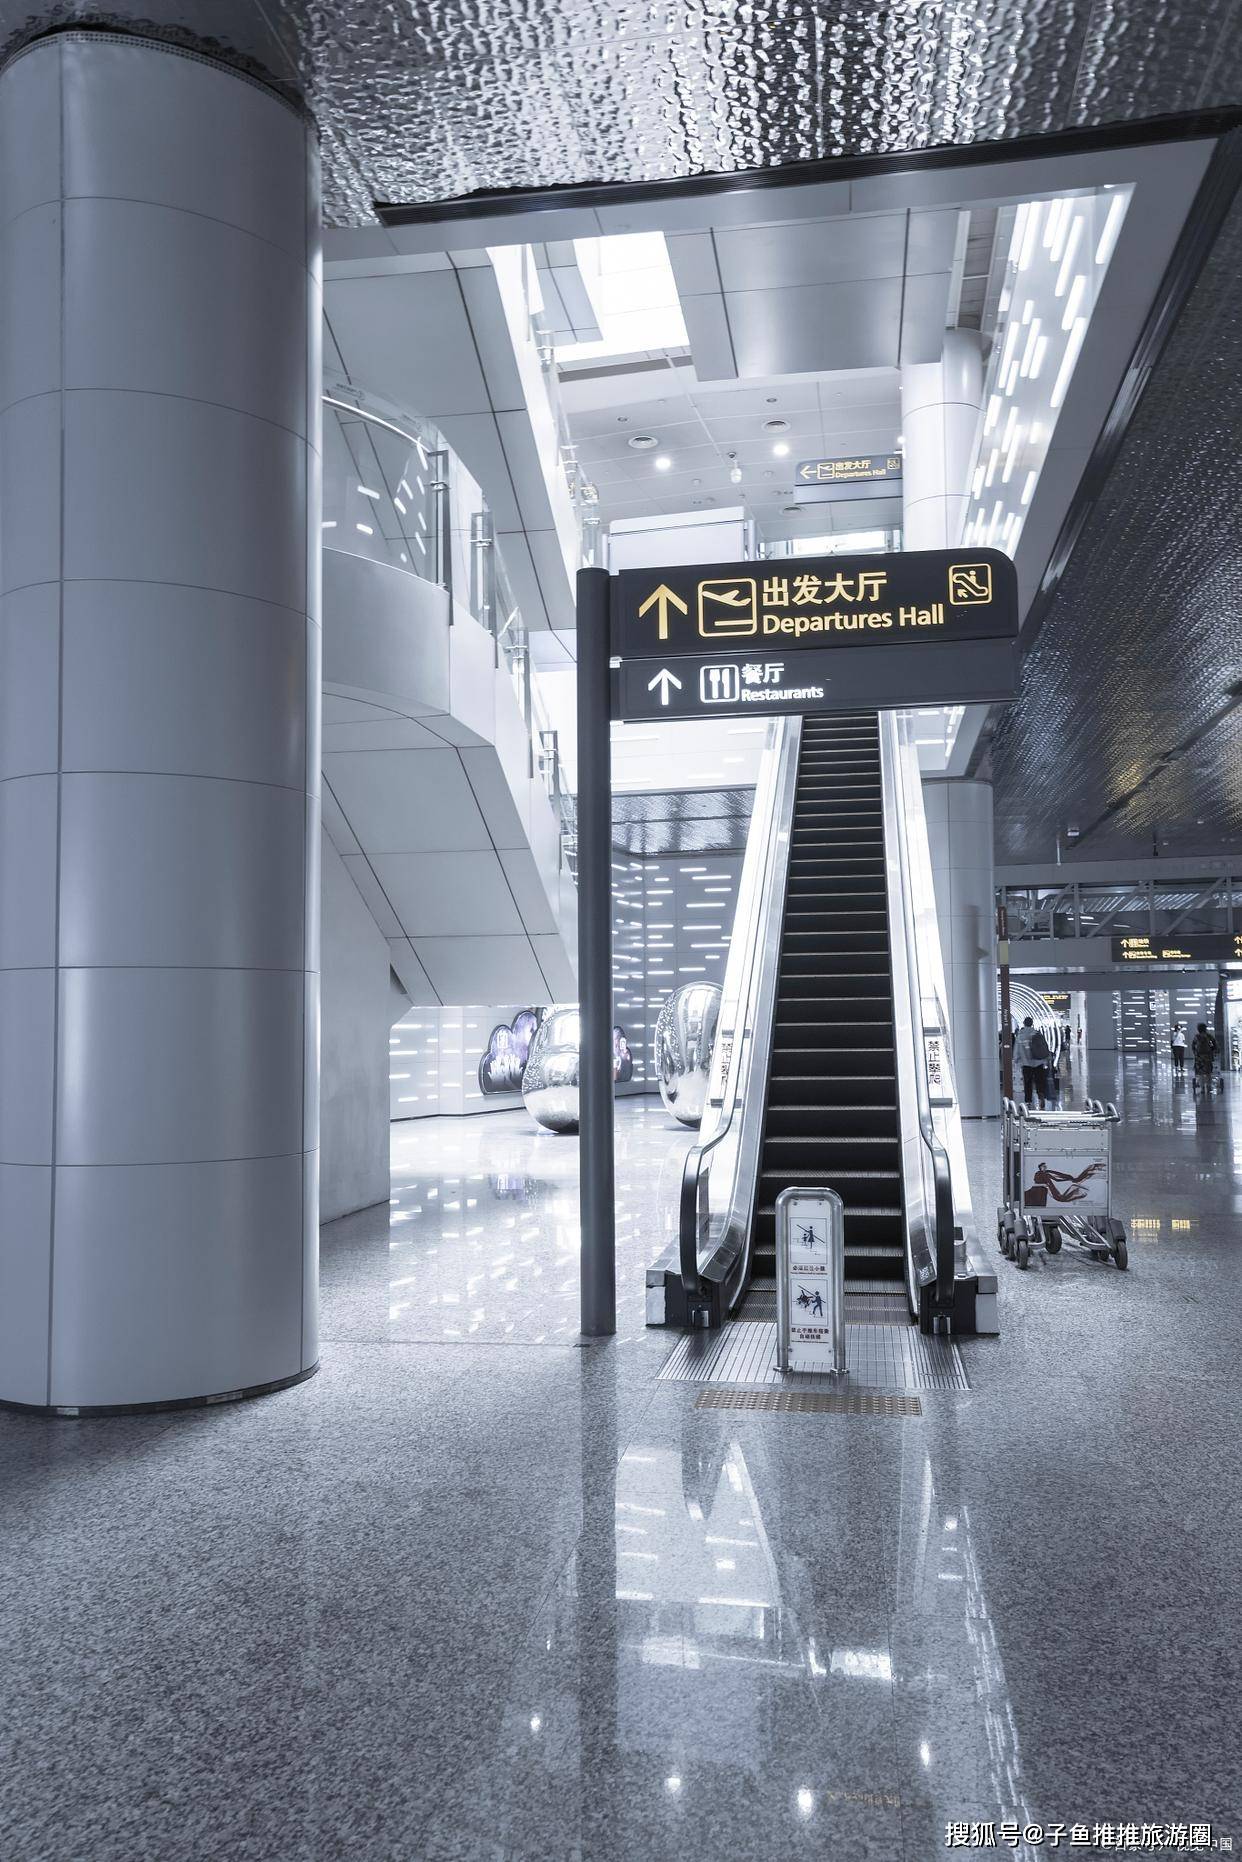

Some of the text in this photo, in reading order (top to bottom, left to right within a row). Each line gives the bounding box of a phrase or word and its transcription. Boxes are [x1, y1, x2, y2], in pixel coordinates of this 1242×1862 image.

[835, 459, 871, 470] 出发大厅
[872, 468, 886, 476] Hall
[762, 571, 887, 607] 出发大厅
[763, 603, 944, 637] Departures Hall
[741, 662, 784, 685] 餐厅
[741, 686, 824, 701] Restaurants
[928, 1040, 941, 1085] 禁止攀爬
